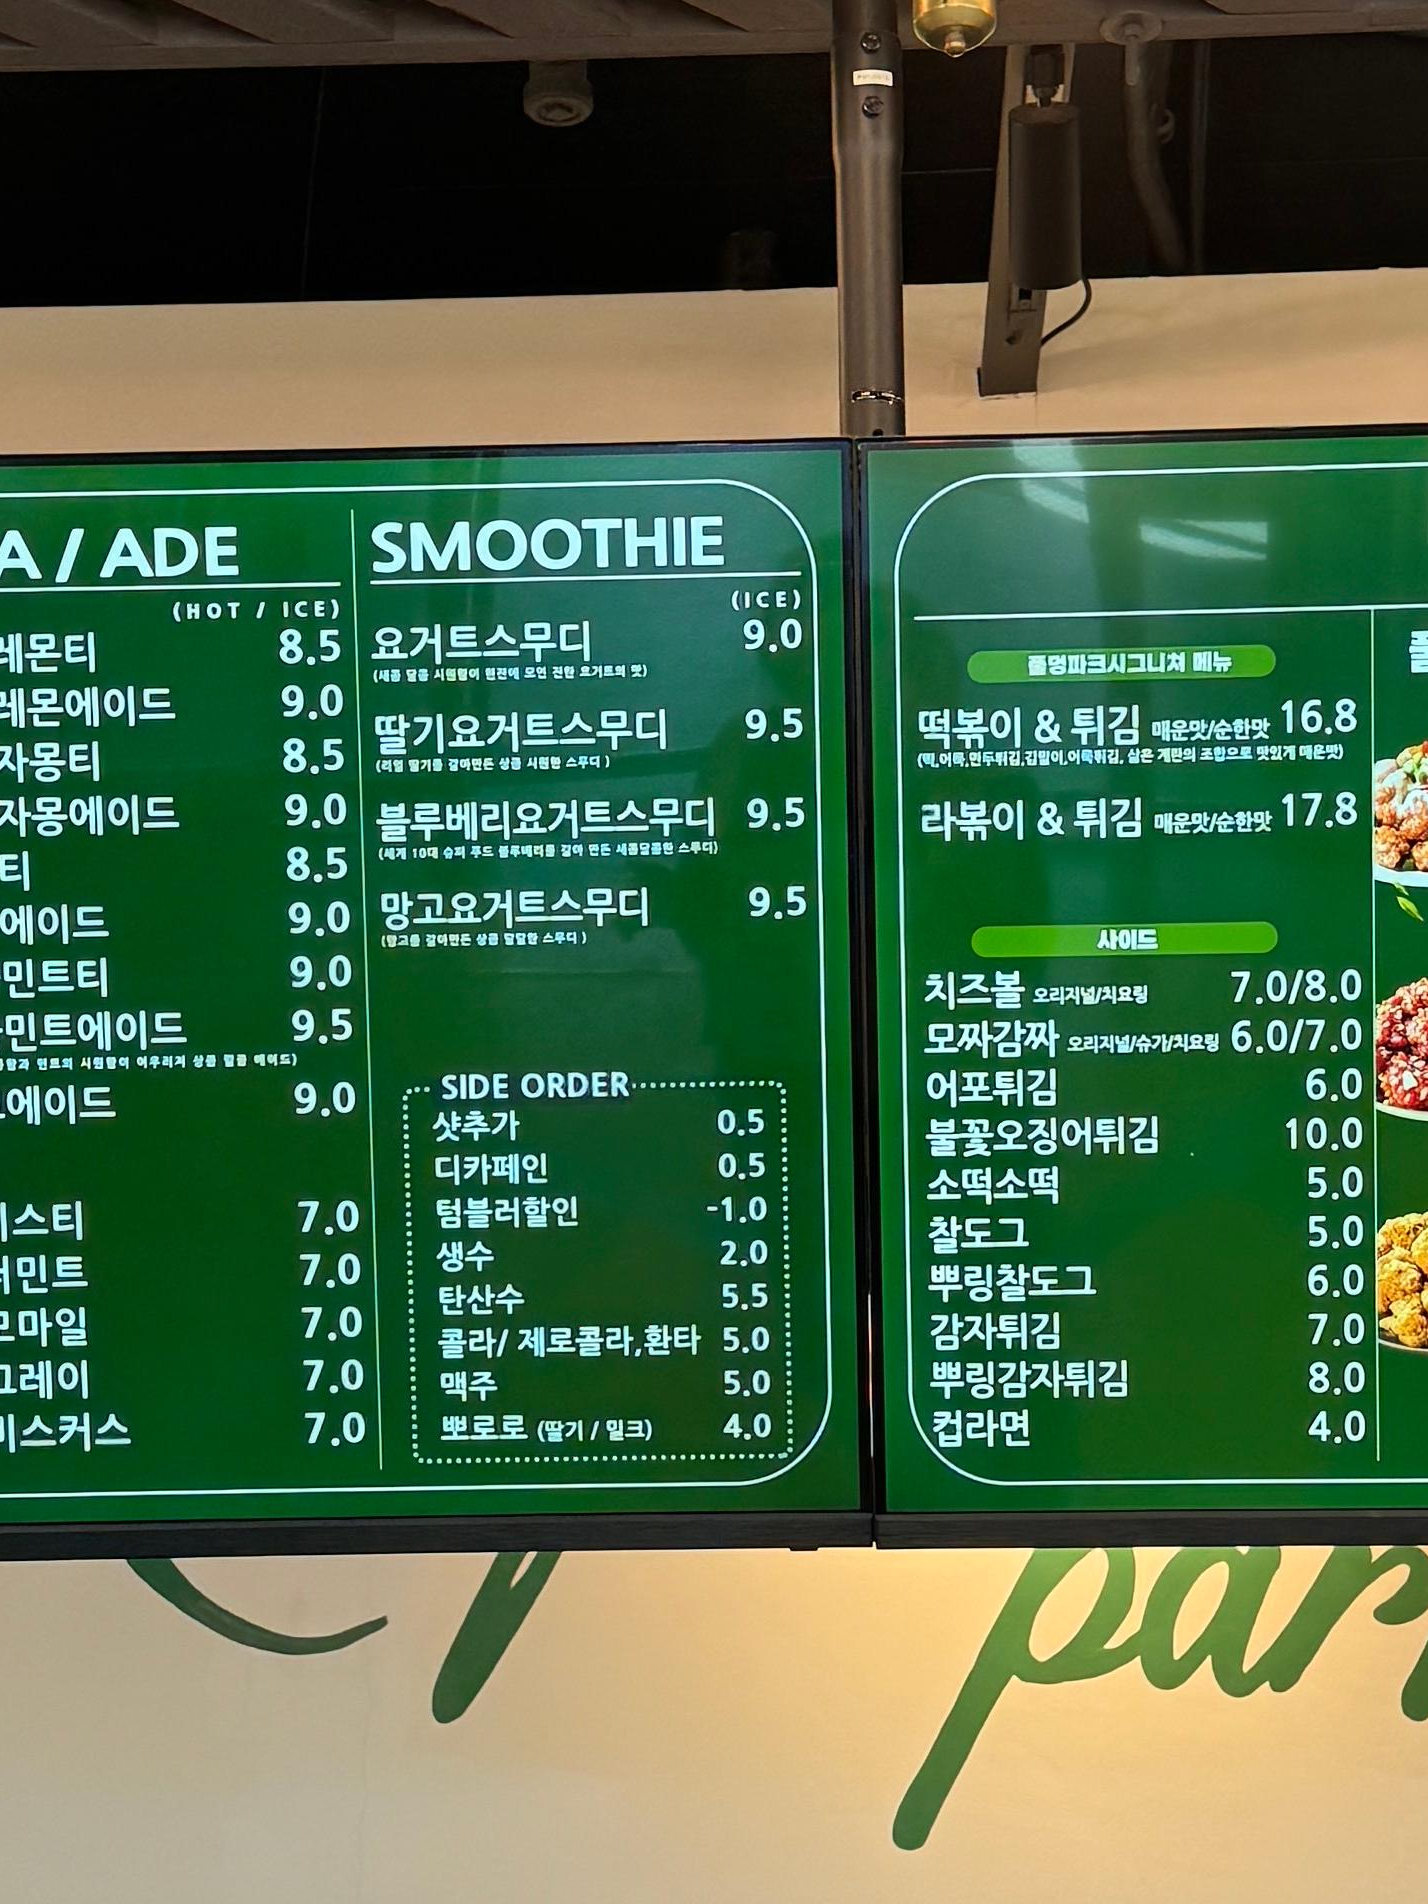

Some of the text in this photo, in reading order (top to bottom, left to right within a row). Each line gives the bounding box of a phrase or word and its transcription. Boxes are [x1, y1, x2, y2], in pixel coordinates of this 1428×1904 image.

[55, 527, 85, 583] /
[99, 526, 240, 578] ADE
[371, 515, 725, 574] SMOOTHIE
[731, 589, 801, 611] (ICE)
[279, 628, 341, 666] 8.5
[370, 618, 803, 665] 요거트스무디 9.0
[1192, 650, 1233, 673] 메뉴
[374, 707, 804, 756] 딸기요거트스무디 9.5
[918, 698, 1358, 750] 떡볶이 & 튀김 매운맛/순한맛 16.8
[284, 792, 347, 829] 9.0
[1096, 928, 1159, 951] 사이드
[924, 968, 1362, 1011] 치즈볼 오리지널/치요링 7.0/8.0
[291, 1008, 353, 1045] 9.5
[441, 1071, 630, 1100] SIDE ORDER
[431, 1108, 765, 1143] 샷추가 0.5
[925, 1115, 1363, 1158] 불꽃오징어튀김 10.0
[297, 1200, 360, 1236] 7.0
[435, 1195, 768, 1229] 텀블러할인 -1.0
[440, 1414, 529, 1441] 뽀로로
[537, 1419, 584, 1443] (딸기
[605, 1418, 653, 1442] 밀크)
[722, 1412, 772, 1441] 4.0
[931, 1409, 1367, 1449] 컵라면 4.0
